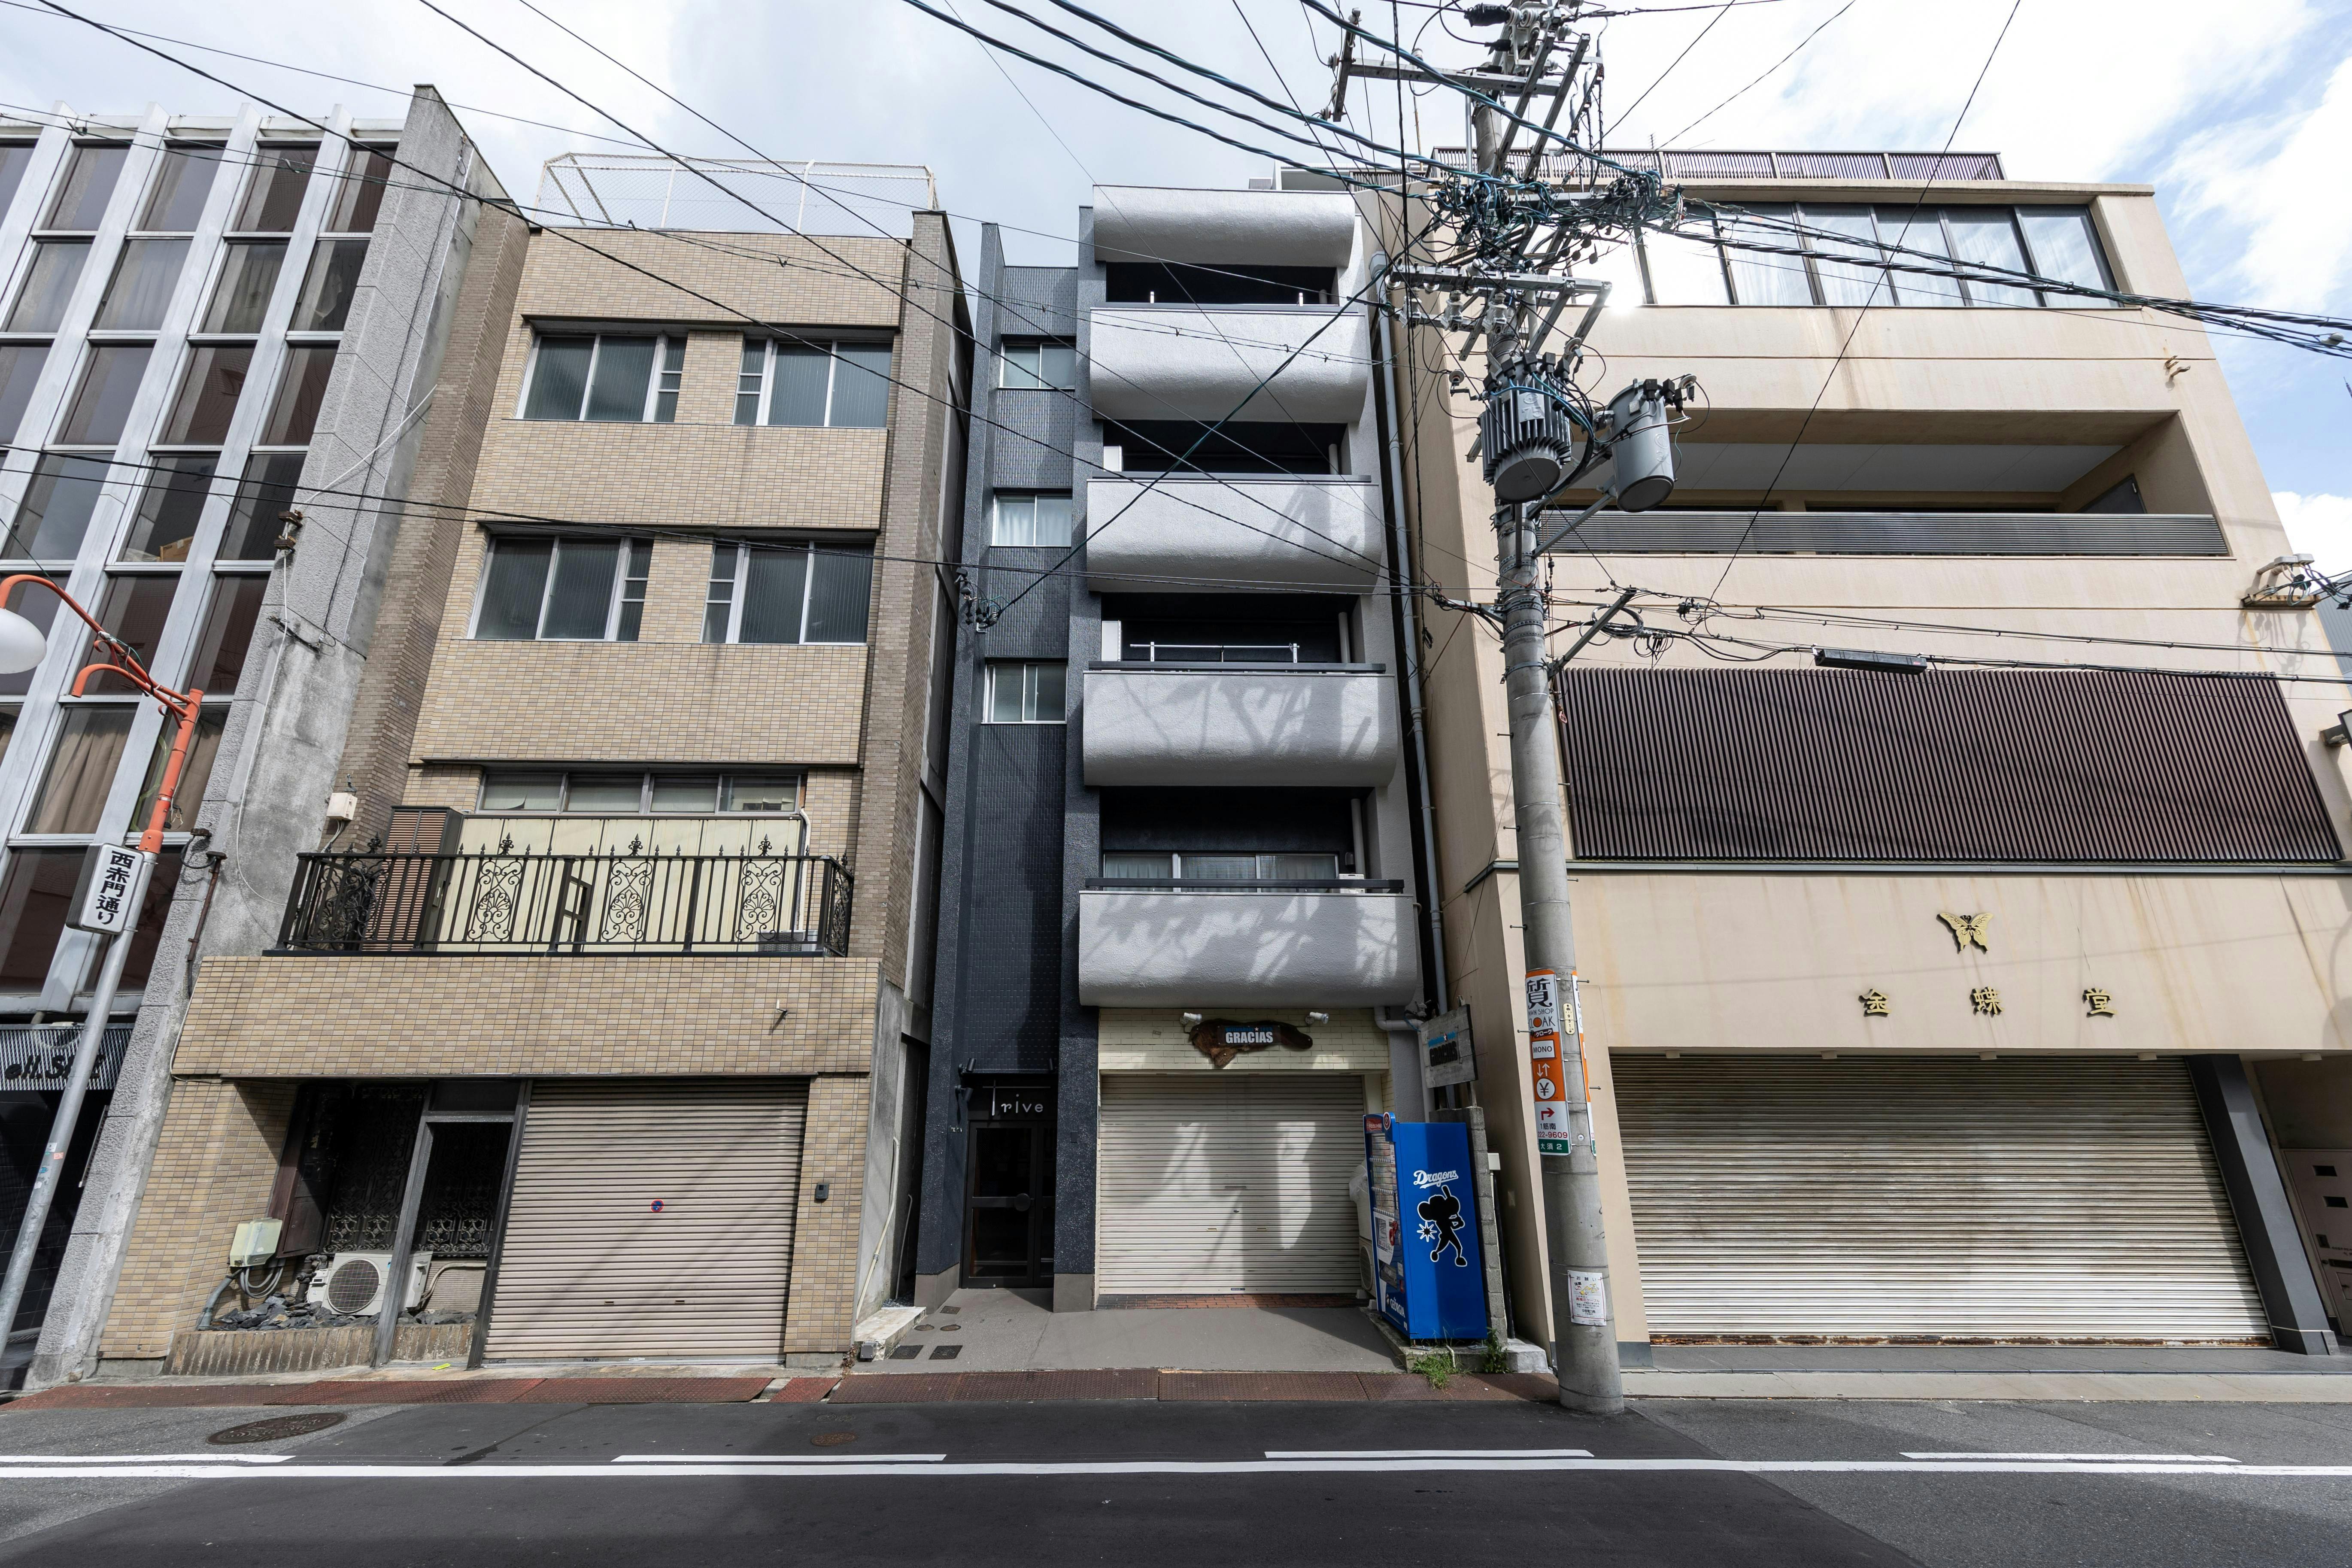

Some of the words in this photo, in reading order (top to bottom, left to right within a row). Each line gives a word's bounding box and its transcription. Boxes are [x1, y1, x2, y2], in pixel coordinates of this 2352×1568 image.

[95, 850, 136, 925] 西赤門通り
[1527, 977, 1552, 1010] 質
[1858, 986, 2118, 1018] 金蝶堂
[1529, 1016, 1556, 1028] CLOAK
[1226, 1032, 1273, 1043] GRACIAS
[1413, 1170, 1459, 1189] Dragons
[1390, 1297, 1405, 1318] GEORGIA
